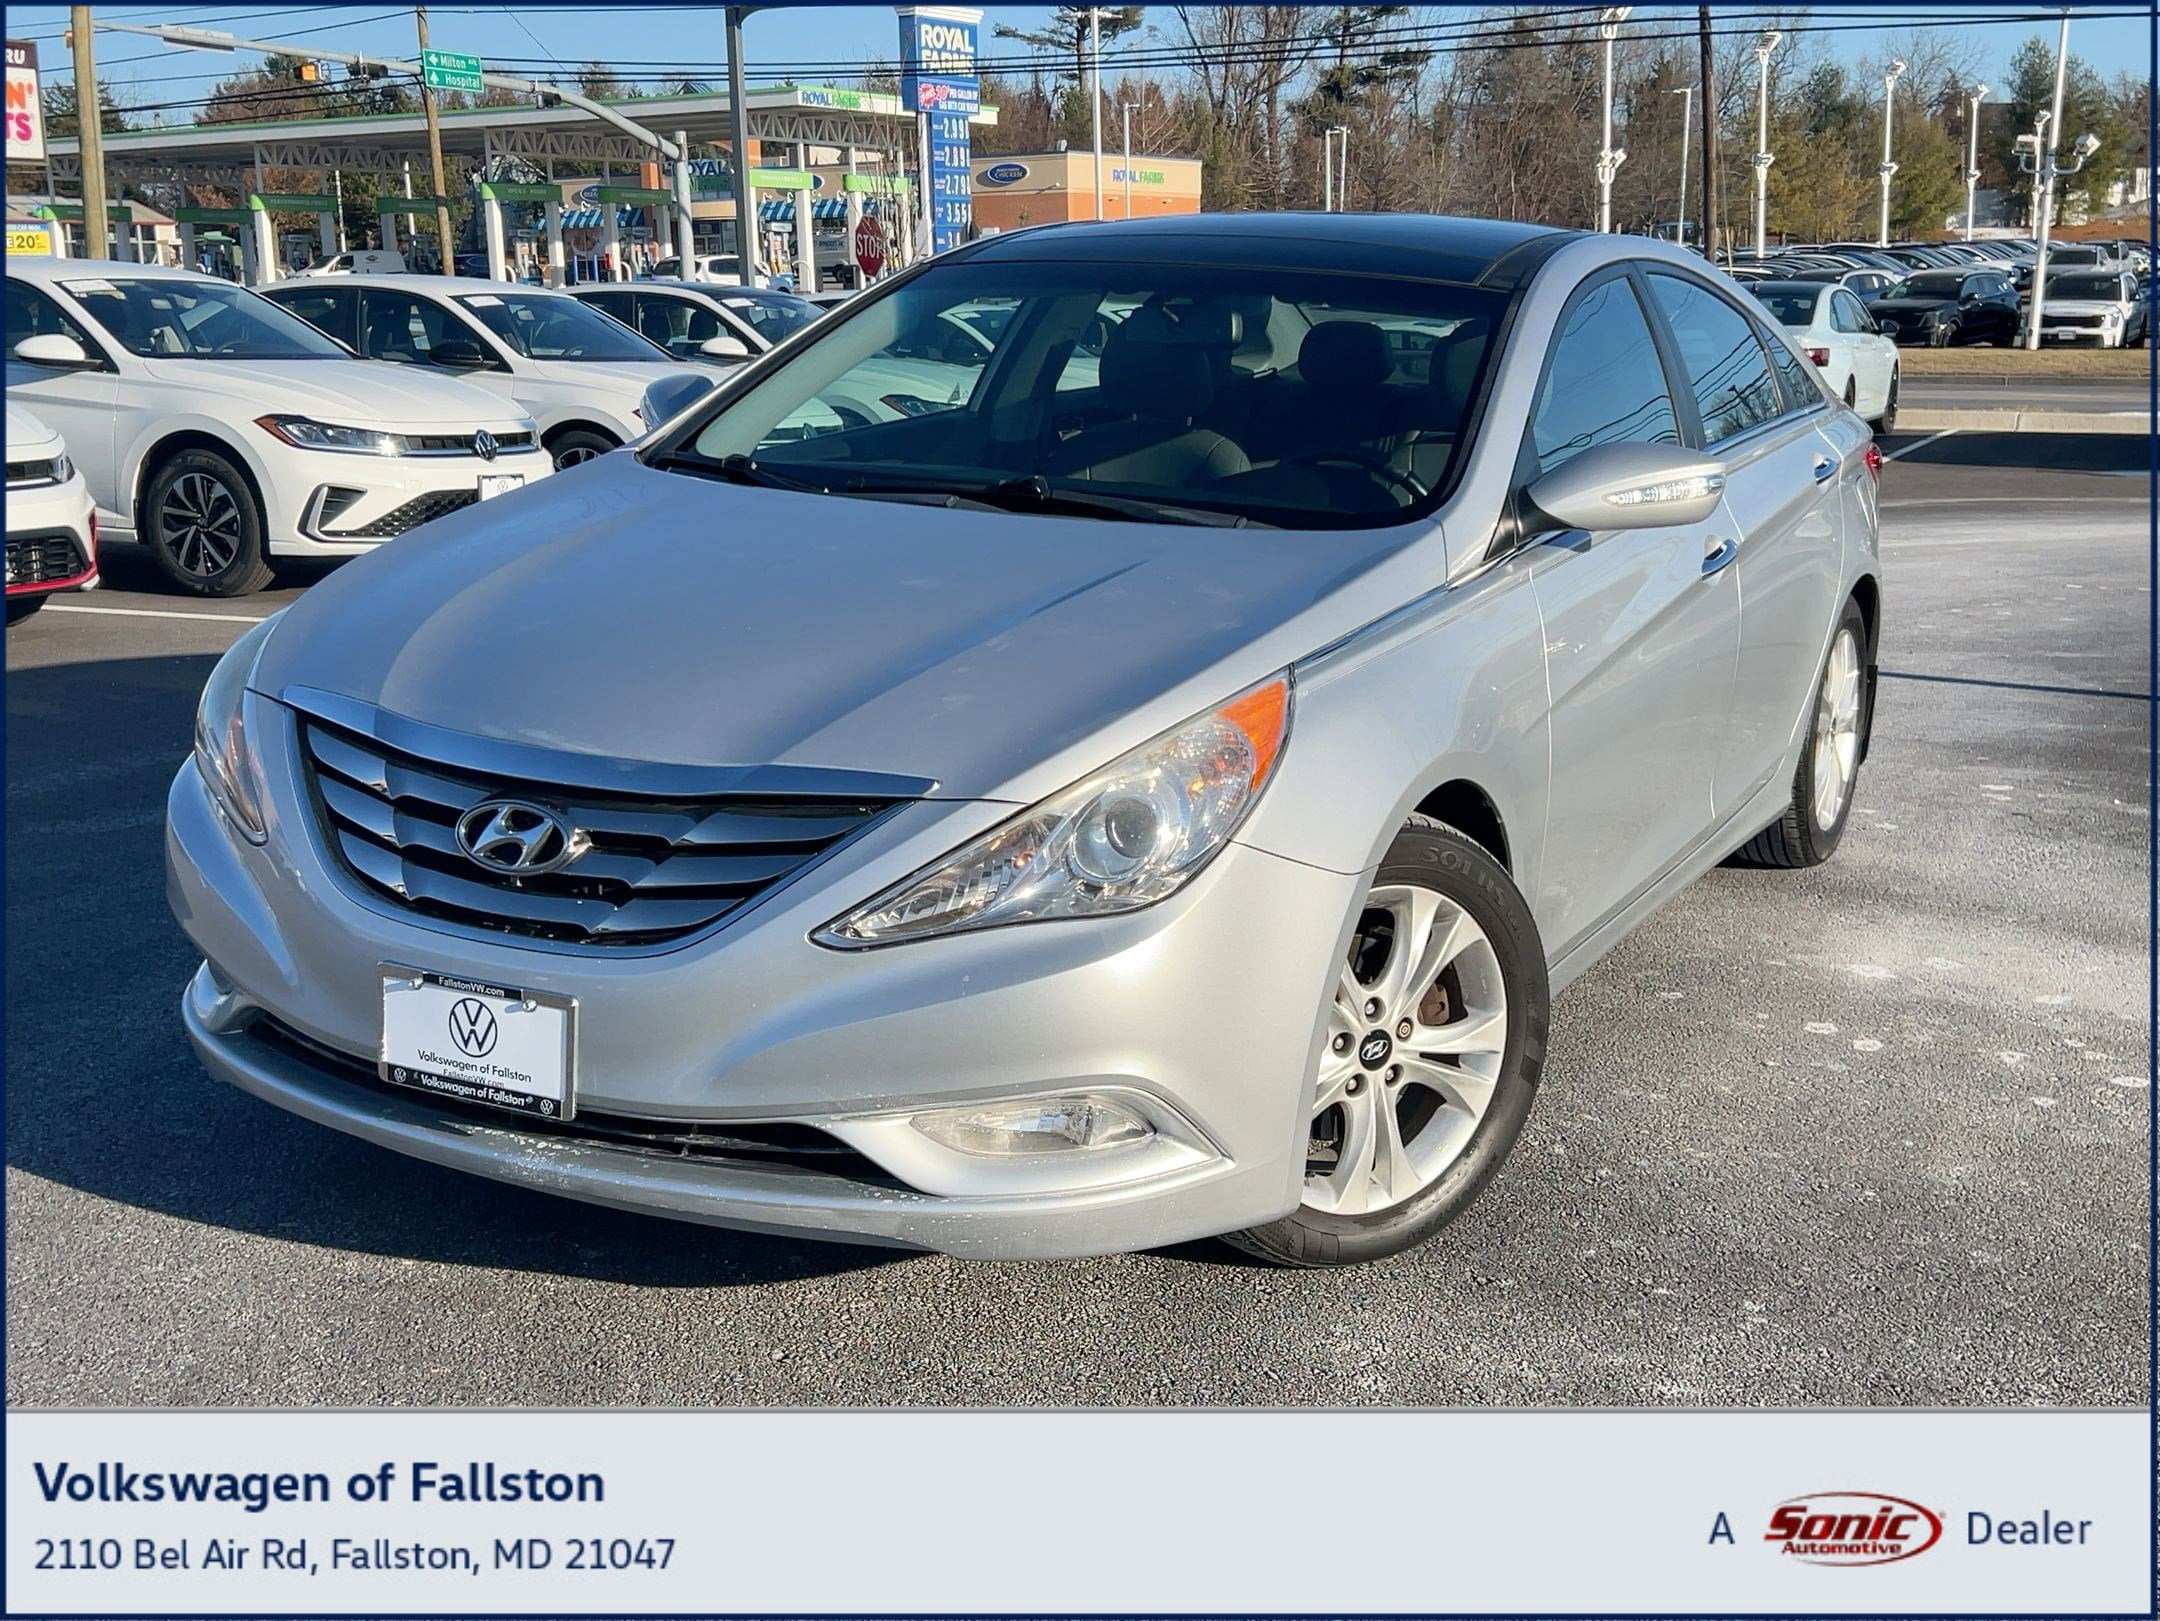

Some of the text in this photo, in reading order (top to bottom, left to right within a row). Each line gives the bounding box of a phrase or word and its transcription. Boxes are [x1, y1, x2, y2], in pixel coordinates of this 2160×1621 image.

[920, 24, 975, 54] ROYAL
[440, 54, 467, 70] Milton
[921, 48, 975, 78] FARMS
[445, 73, 480, 88] Hospital
[802, 91, 832, 106] ROYAL
[949, 88, 957, 98] PER
[856, 233, 883, 259] STOP
[438, 976, 505, 998] FallstonVW.com
[417, 1048, 532, 1083] Volkswagen of Fallston
[420, 1073, 476, 1096] Volkswagen
[477, 1086, 488, 1099] of
[488, 1088, 525, 1107] Fallston
